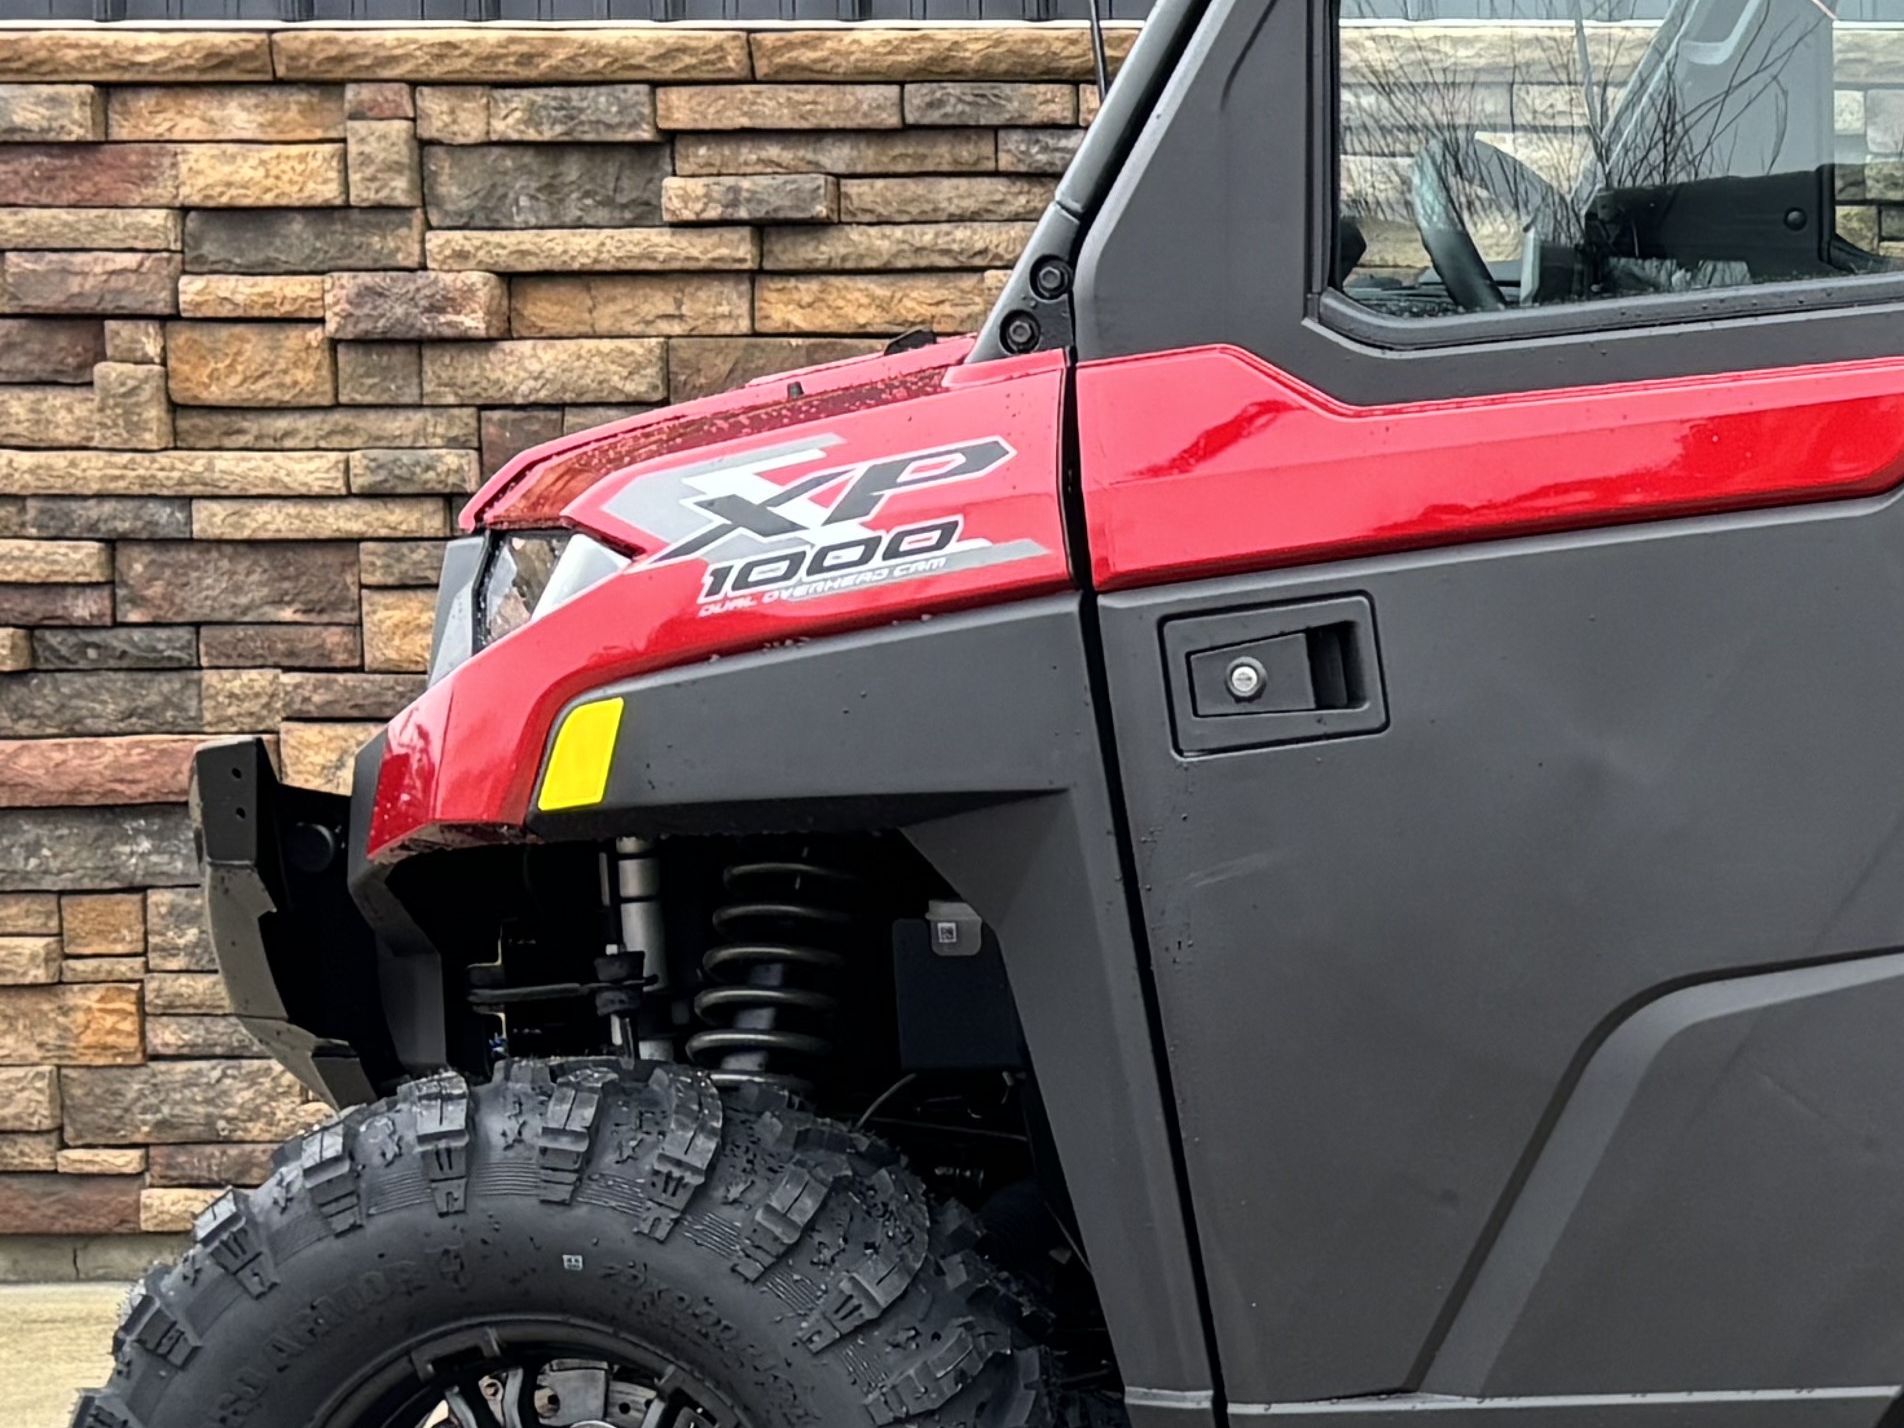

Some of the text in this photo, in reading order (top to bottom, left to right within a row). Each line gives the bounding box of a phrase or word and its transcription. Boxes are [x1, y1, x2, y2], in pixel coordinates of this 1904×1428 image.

[648, 435, 1016, 566] XP
[697, 515, 963, 604] 1000
[698, 557, 947, 617] DUAL OVERHEAD CAM
